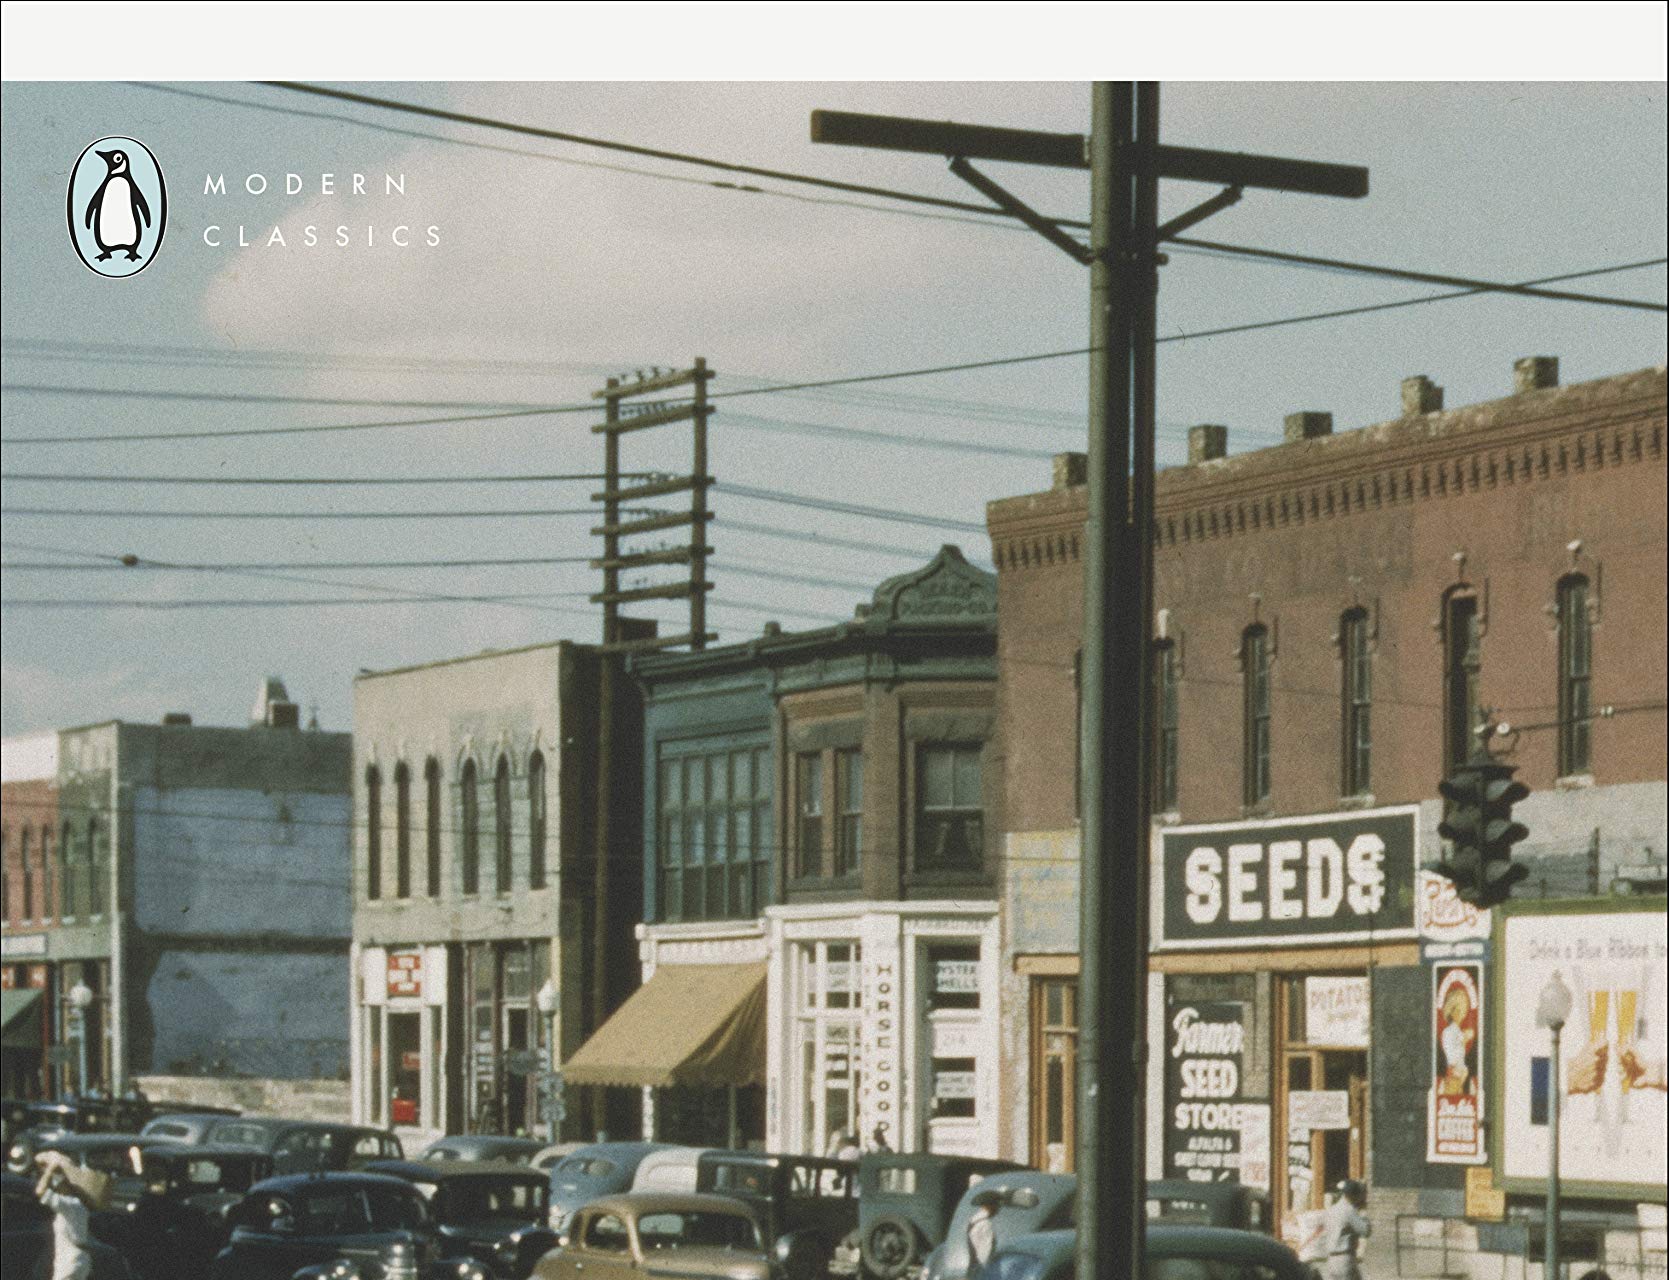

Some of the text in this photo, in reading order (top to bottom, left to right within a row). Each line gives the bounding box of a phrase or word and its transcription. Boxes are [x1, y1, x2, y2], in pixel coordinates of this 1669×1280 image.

[1185, 833, 1385, 924] SEEDS
[876, 963, 892, 1049] HORSE
[1181, 1059, 1239, 1098] SEED
[1174, 1103, 1247, 1130] STORE
